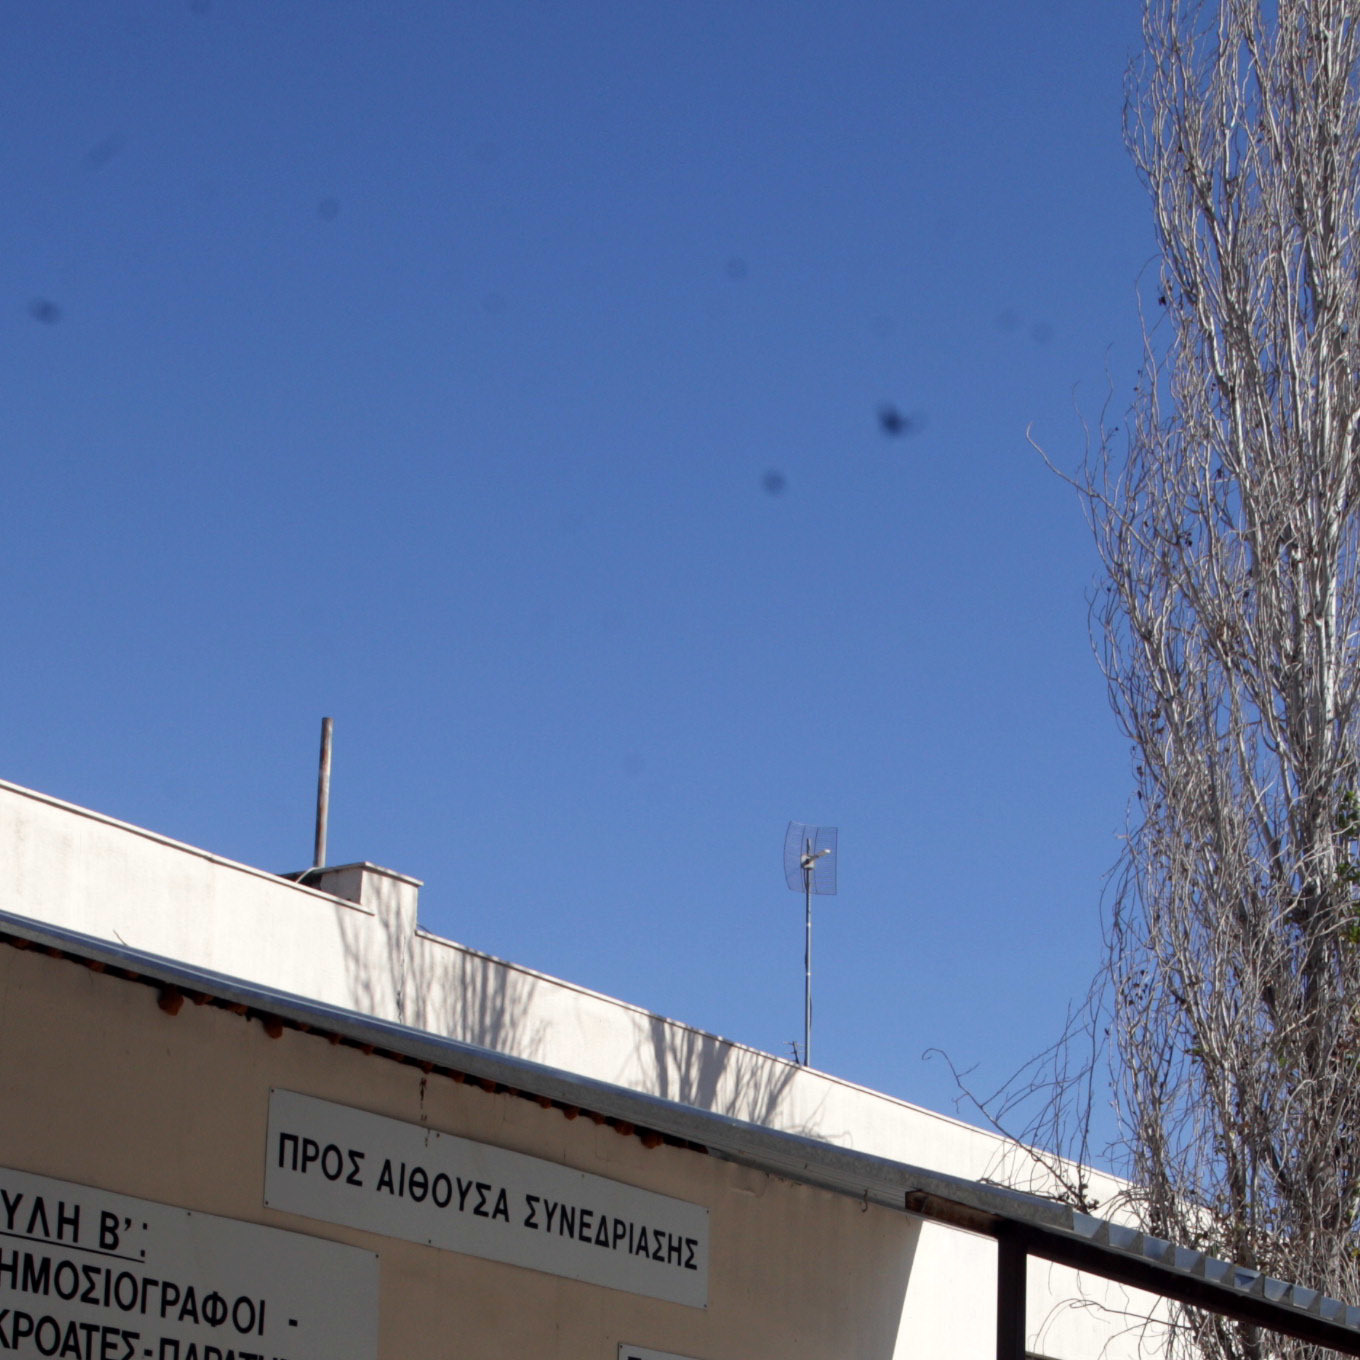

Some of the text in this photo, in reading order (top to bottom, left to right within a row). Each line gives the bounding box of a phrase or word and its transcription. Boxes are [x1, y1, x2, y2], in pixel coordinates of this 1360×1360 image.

[278, 1132, 698, 1271] ΠΡΟΣ ΑΙΘΟΥΣΑ ΣΥΝΕΔΡΙΑΣΗΣ
